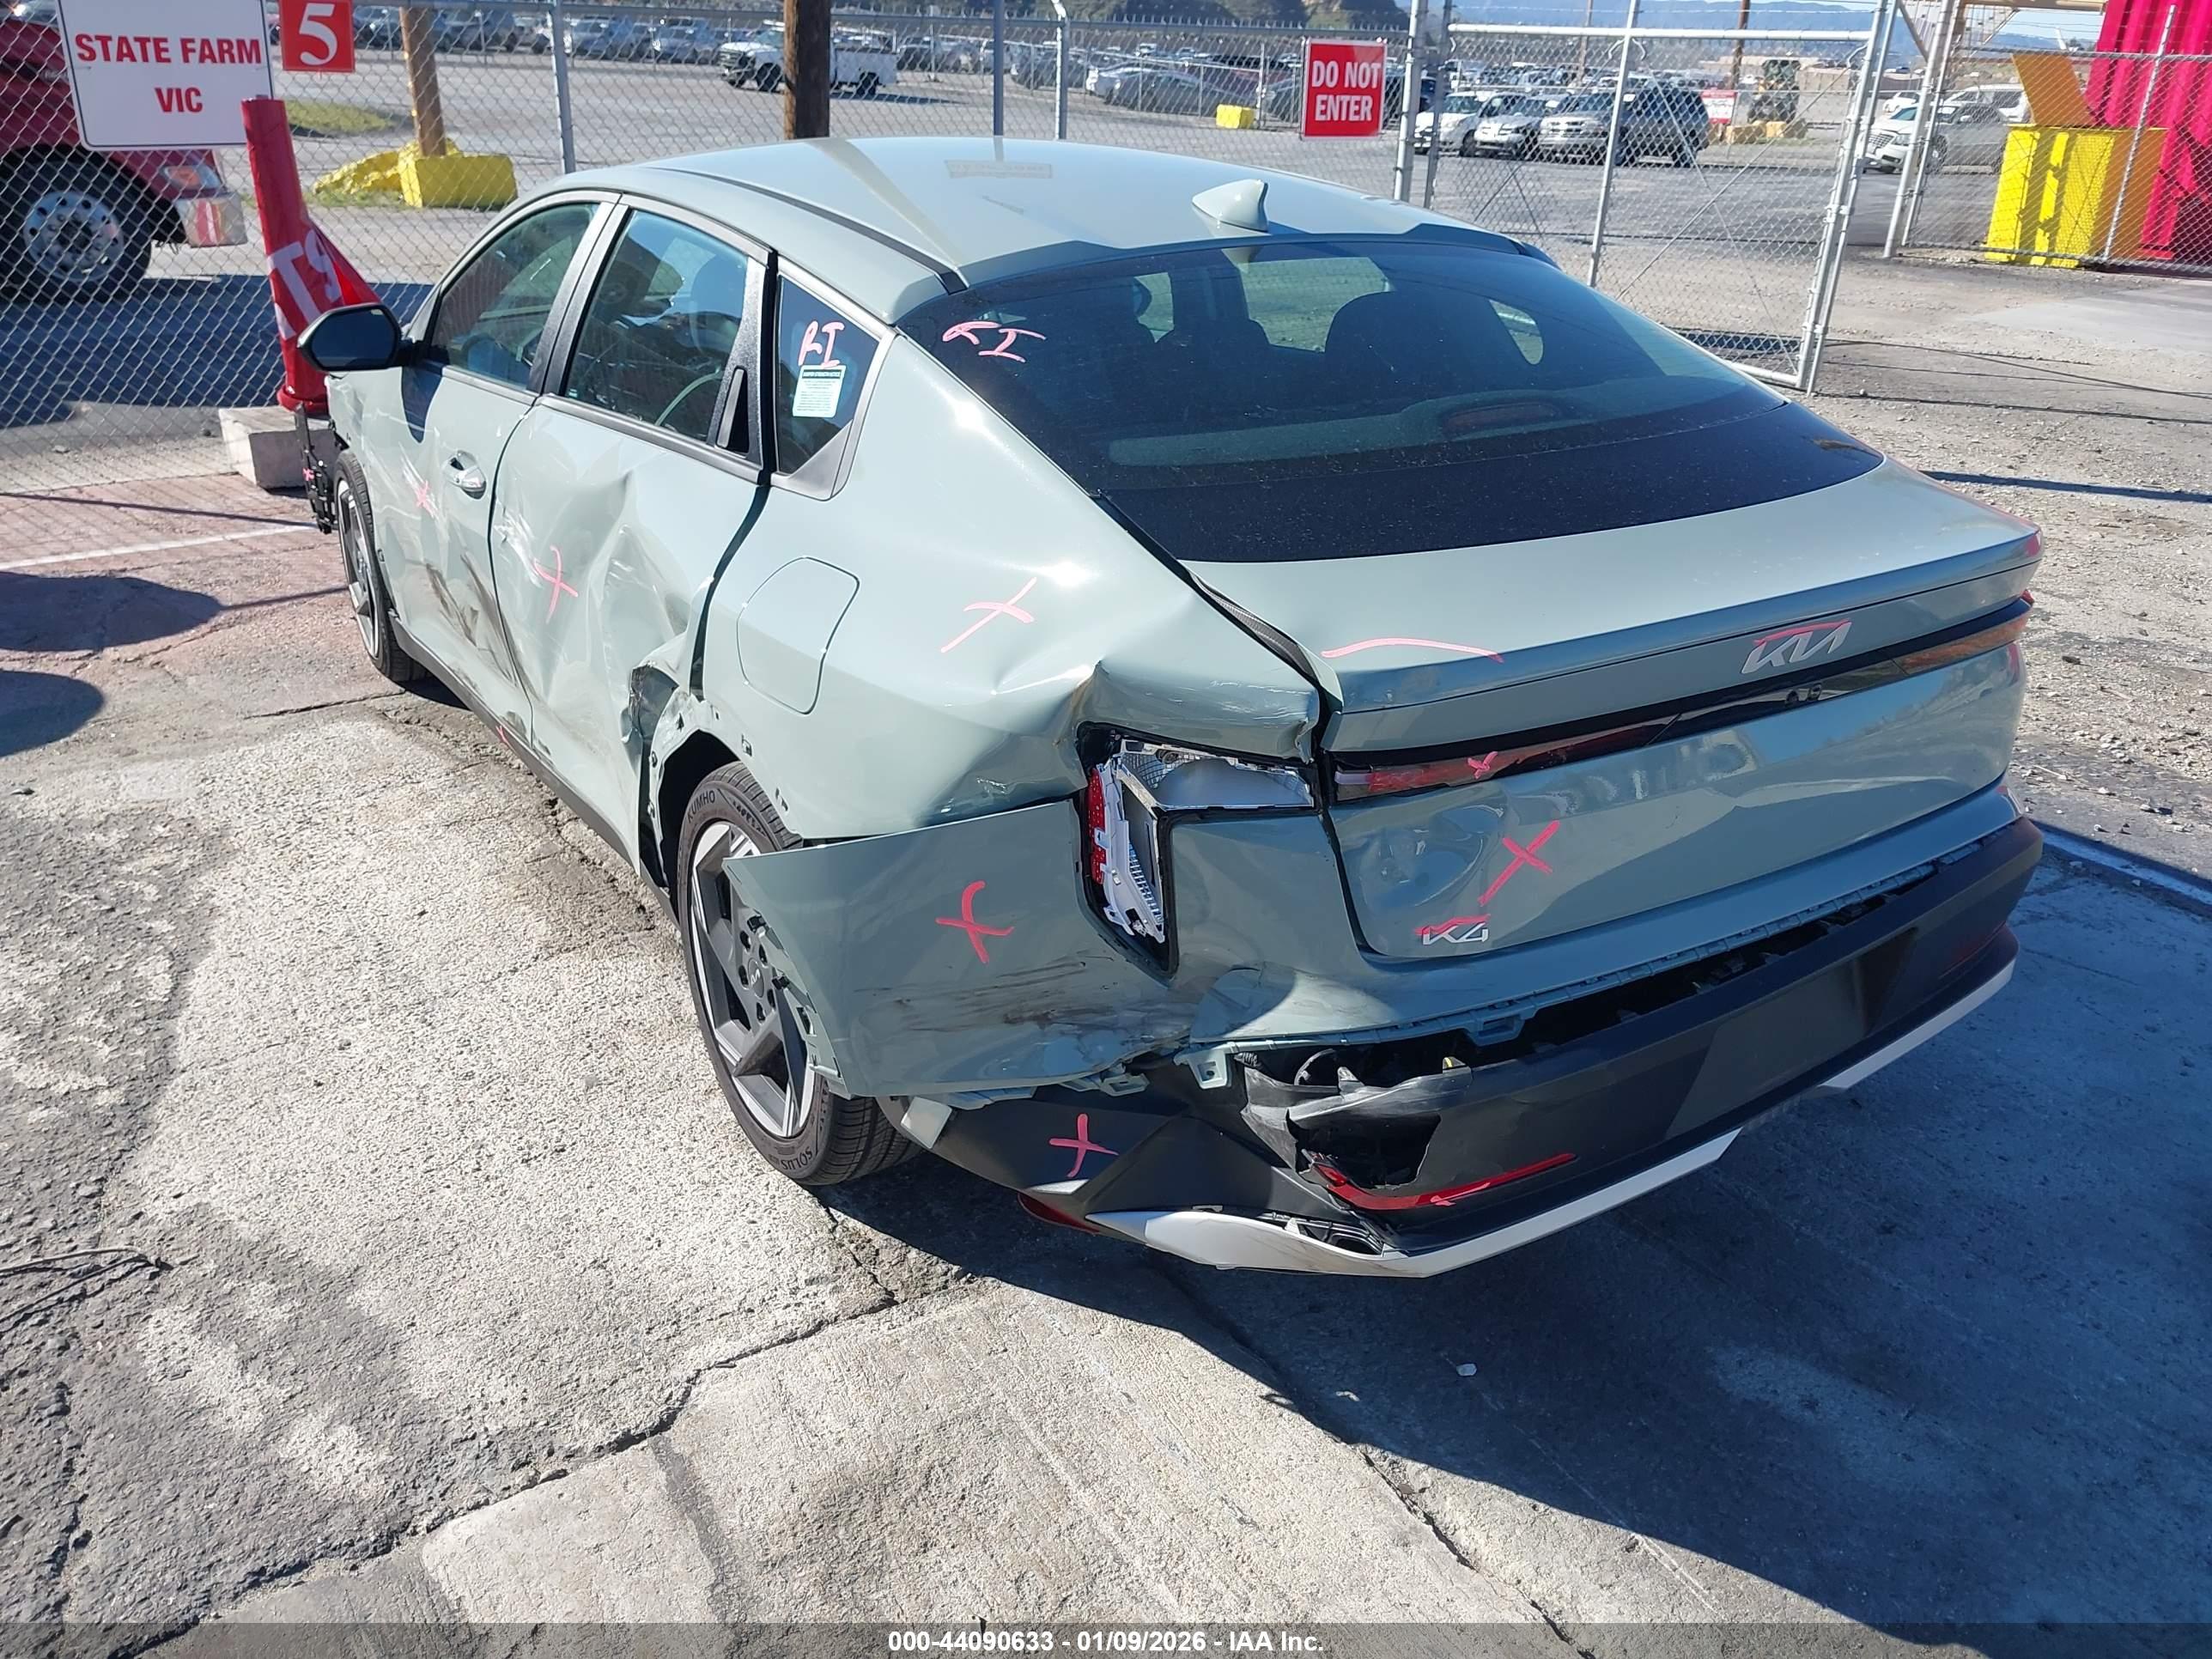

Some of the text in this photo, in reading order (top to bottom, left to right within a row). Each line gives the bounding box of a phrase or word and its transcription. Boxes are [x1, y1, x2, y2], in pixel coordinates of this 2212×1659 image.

[299, 3, 338, 66] 5
[75, 33, 262, 64] STATE FARM
[1311, 60, 1382, 88] DO NOT
[155, 87, 204, 113] VIC
[1315, 94, 1373, 121] ENTER
[687, 789, 716, 823] KUMHO
[1422, 922, 1489, 945] K4
[781, 1146, 813, 1170] SOLUS
